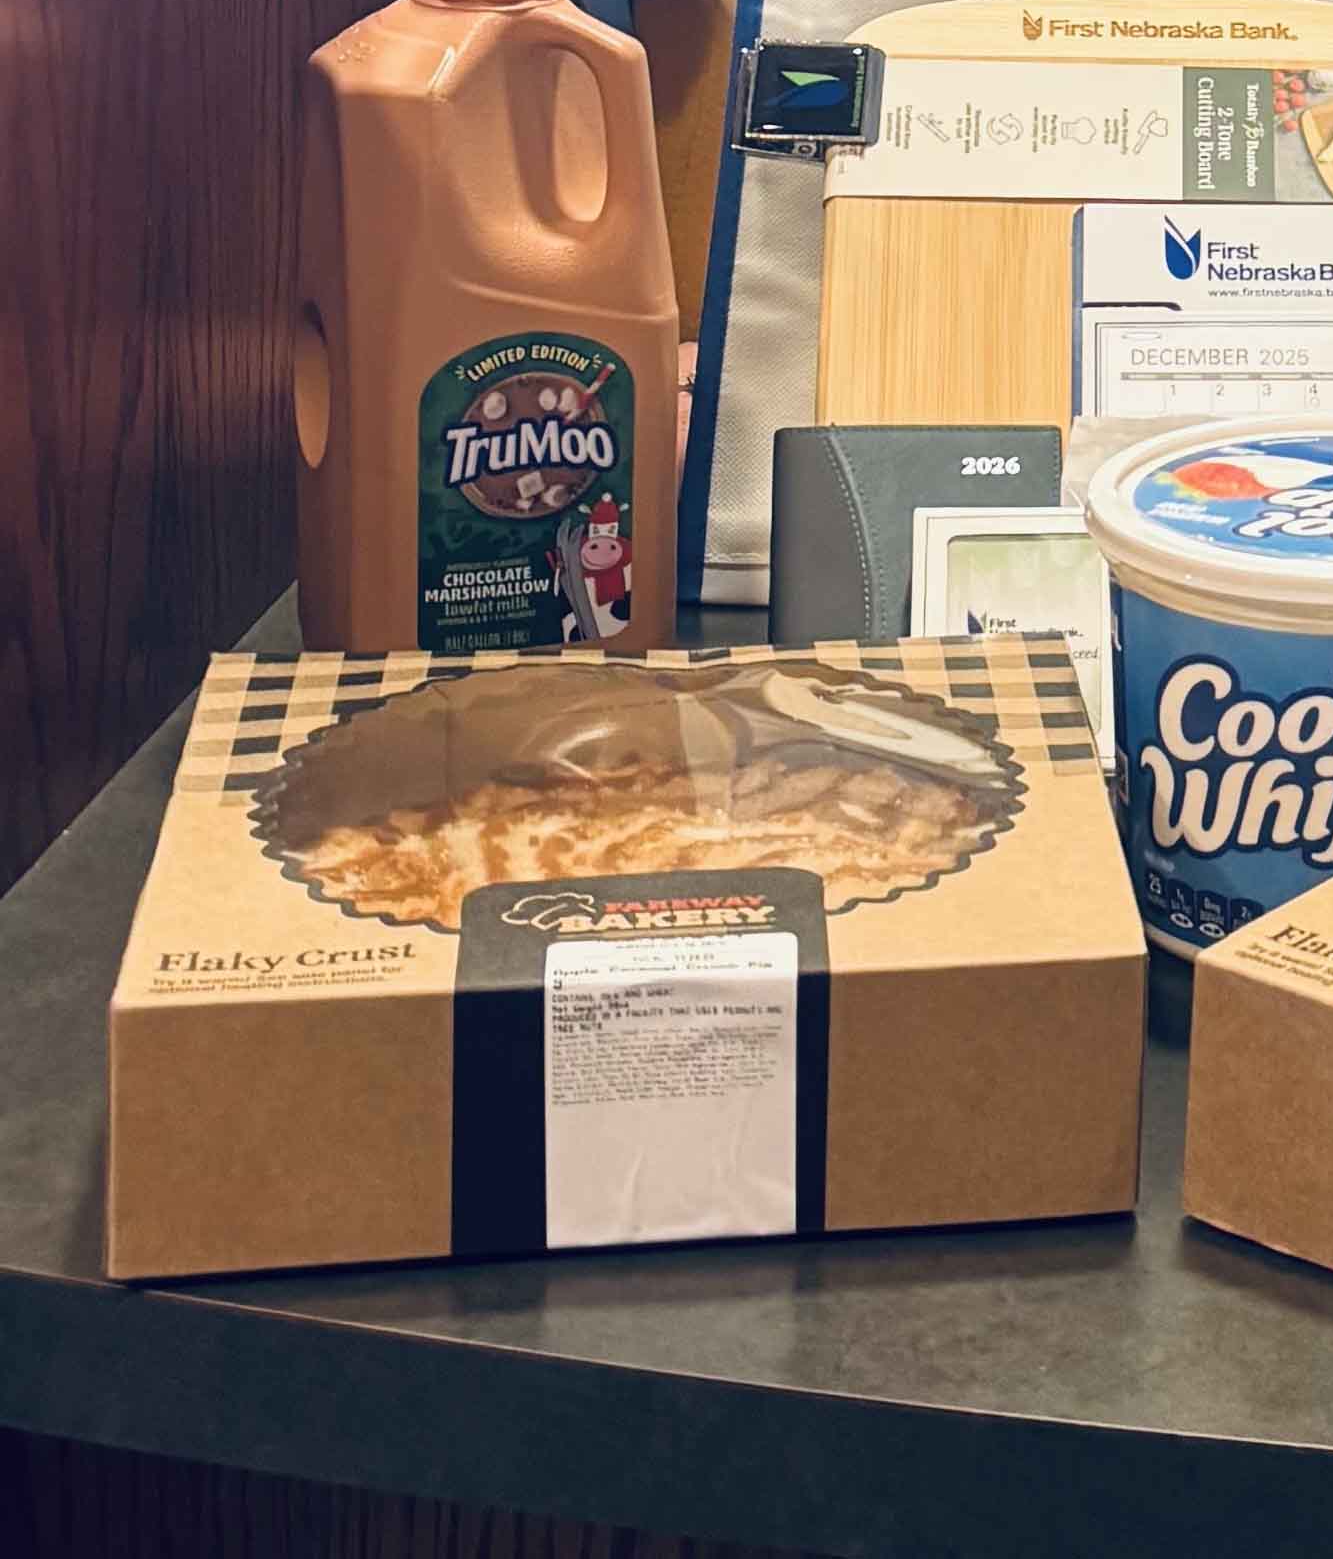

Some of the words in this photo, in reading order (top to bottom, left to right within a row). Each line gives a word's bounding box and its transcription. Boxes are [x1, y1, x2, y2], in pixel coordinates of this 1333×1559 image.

[1049, 19, 1104, 39] First
[1111, 20, 1223, 39] Nebraska
[1193, 77, 1216, 138] Cutting
[1246, 82, 1260, 123] Totally
[1217, 106, 1234, 161] 2-Tone
[1198, 141, 1216, 190] Board
[1246, 140, 1260, 187] Bamboo
[1208, 242, 1260, 261] First
[1207, 263, 1317, 282] Nebraska
[467, 345, 526, 382] LIMITED
[531, 343, 591, 372] EDITION
[1131, 348, 1249, 366] DECEMBER
[1259, 348, 1310, 367] 2025
[1216, 385, 1225, 397] 2
[1262, 385, 1271, 397] 3
[1308, 384, 1318, 397] 4
[445, 418, 614, 485] TruMoo
[961, 456, 1021, 475] 2026
[443, 566, 532, 588] CHOCOLATE
[424, 579, 550, 603] MARSHMALLOW
[445, 600, 493, 618] lowfat
[496, 595, 530, 611] milk
[604, 894, 766, 914] FAREWAY
[556, 905, 776, 934] BAKERY
[158, 950, 287, 974] Flaky
[295, 942, 417, 968] Crust
